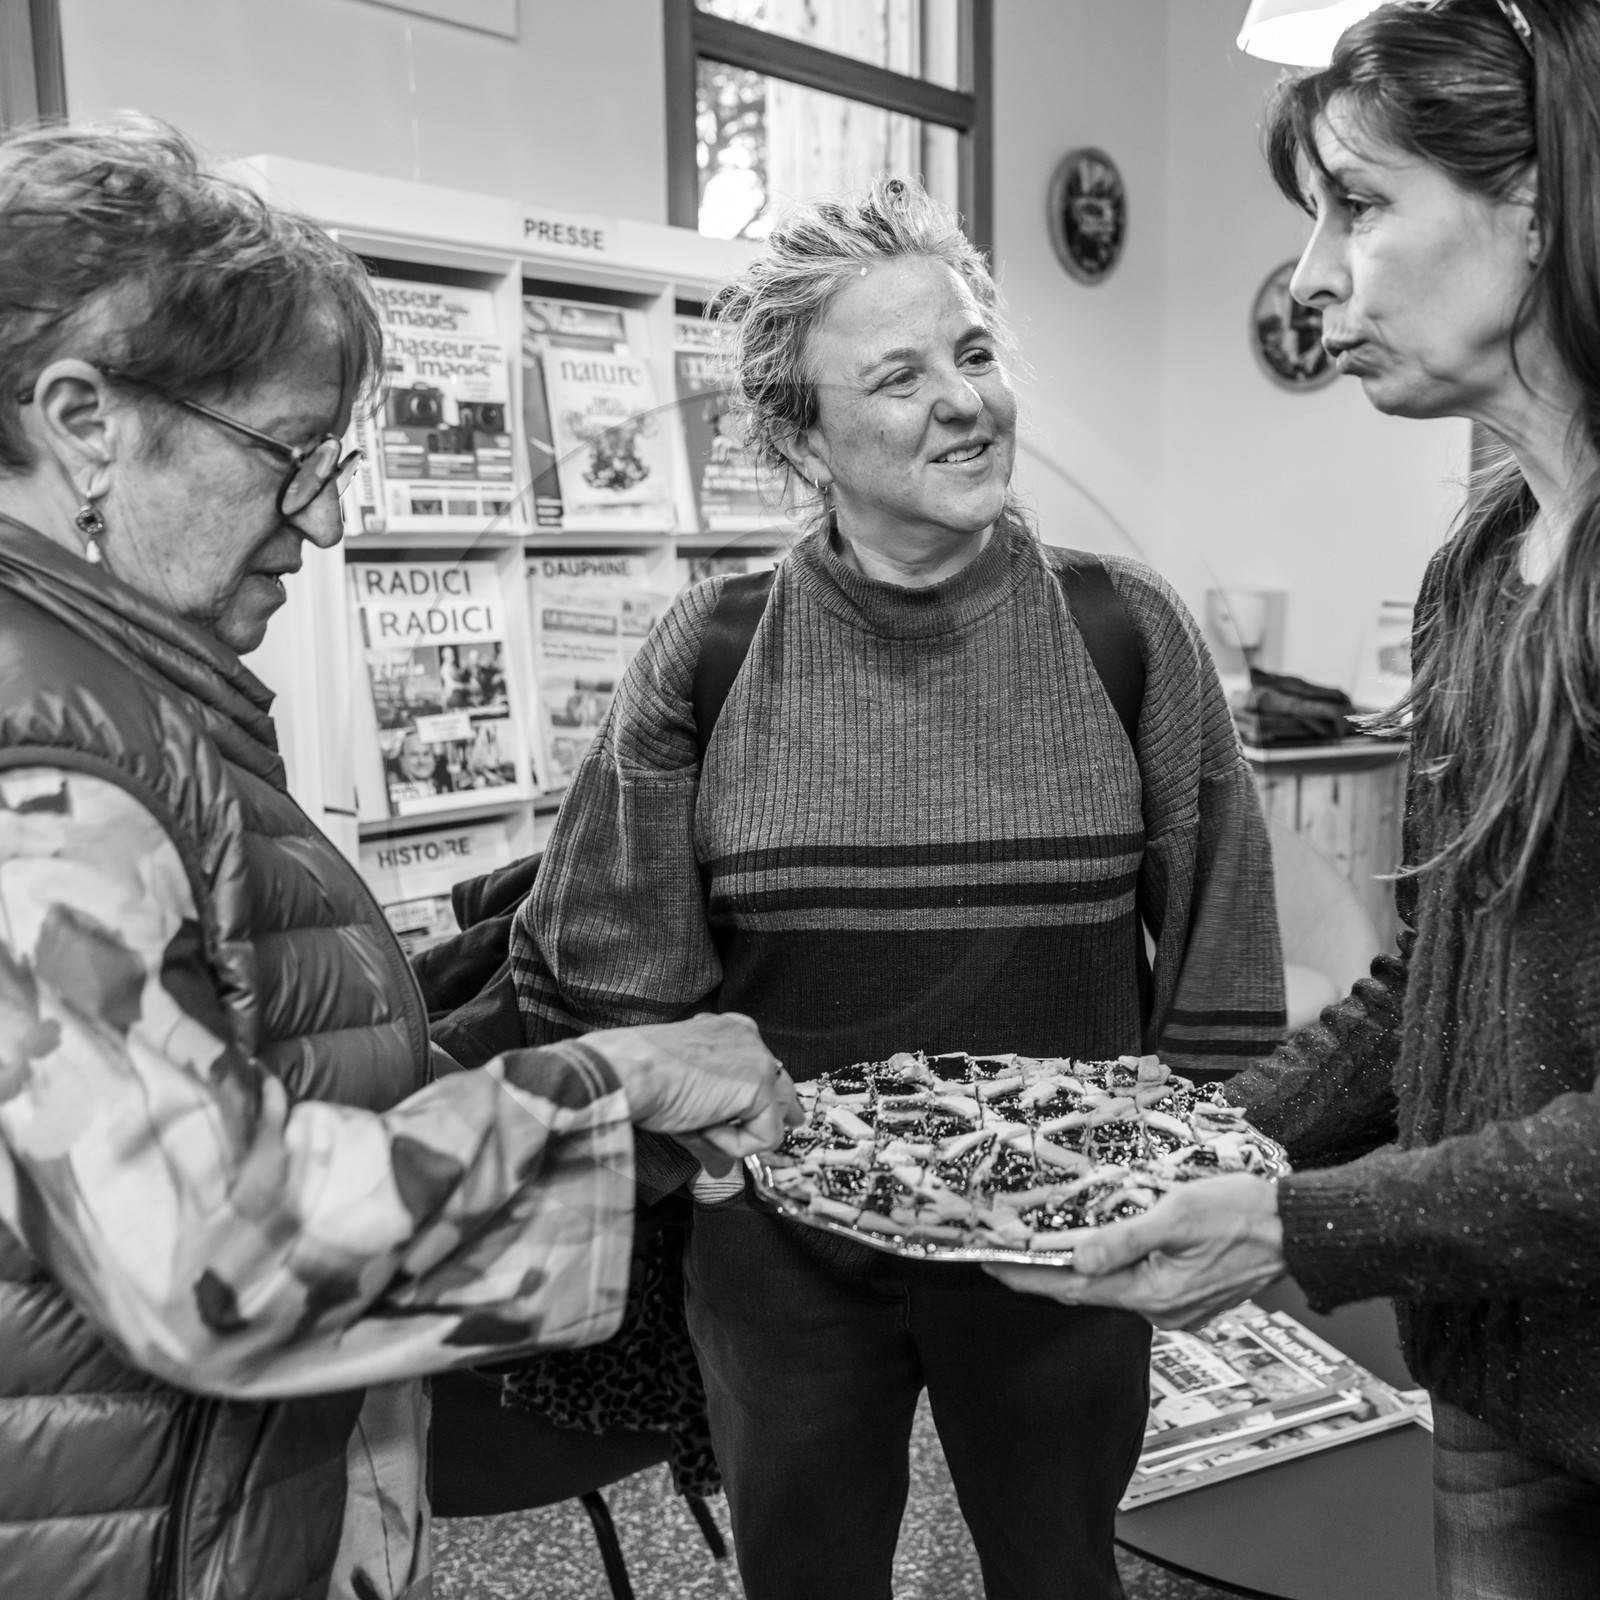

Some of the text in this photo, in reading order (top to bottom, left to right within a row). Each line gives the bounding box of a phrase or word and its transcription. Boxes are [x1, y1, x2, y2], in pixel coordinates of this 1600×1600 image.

[524, 217, 606, 251] PRESSE
[376, 287, 442, 308] asseur
[560, 361, 642, 386] nature
[365, 568, 471, 595] RADICI
[379, 606, 493, 637] RADICI
